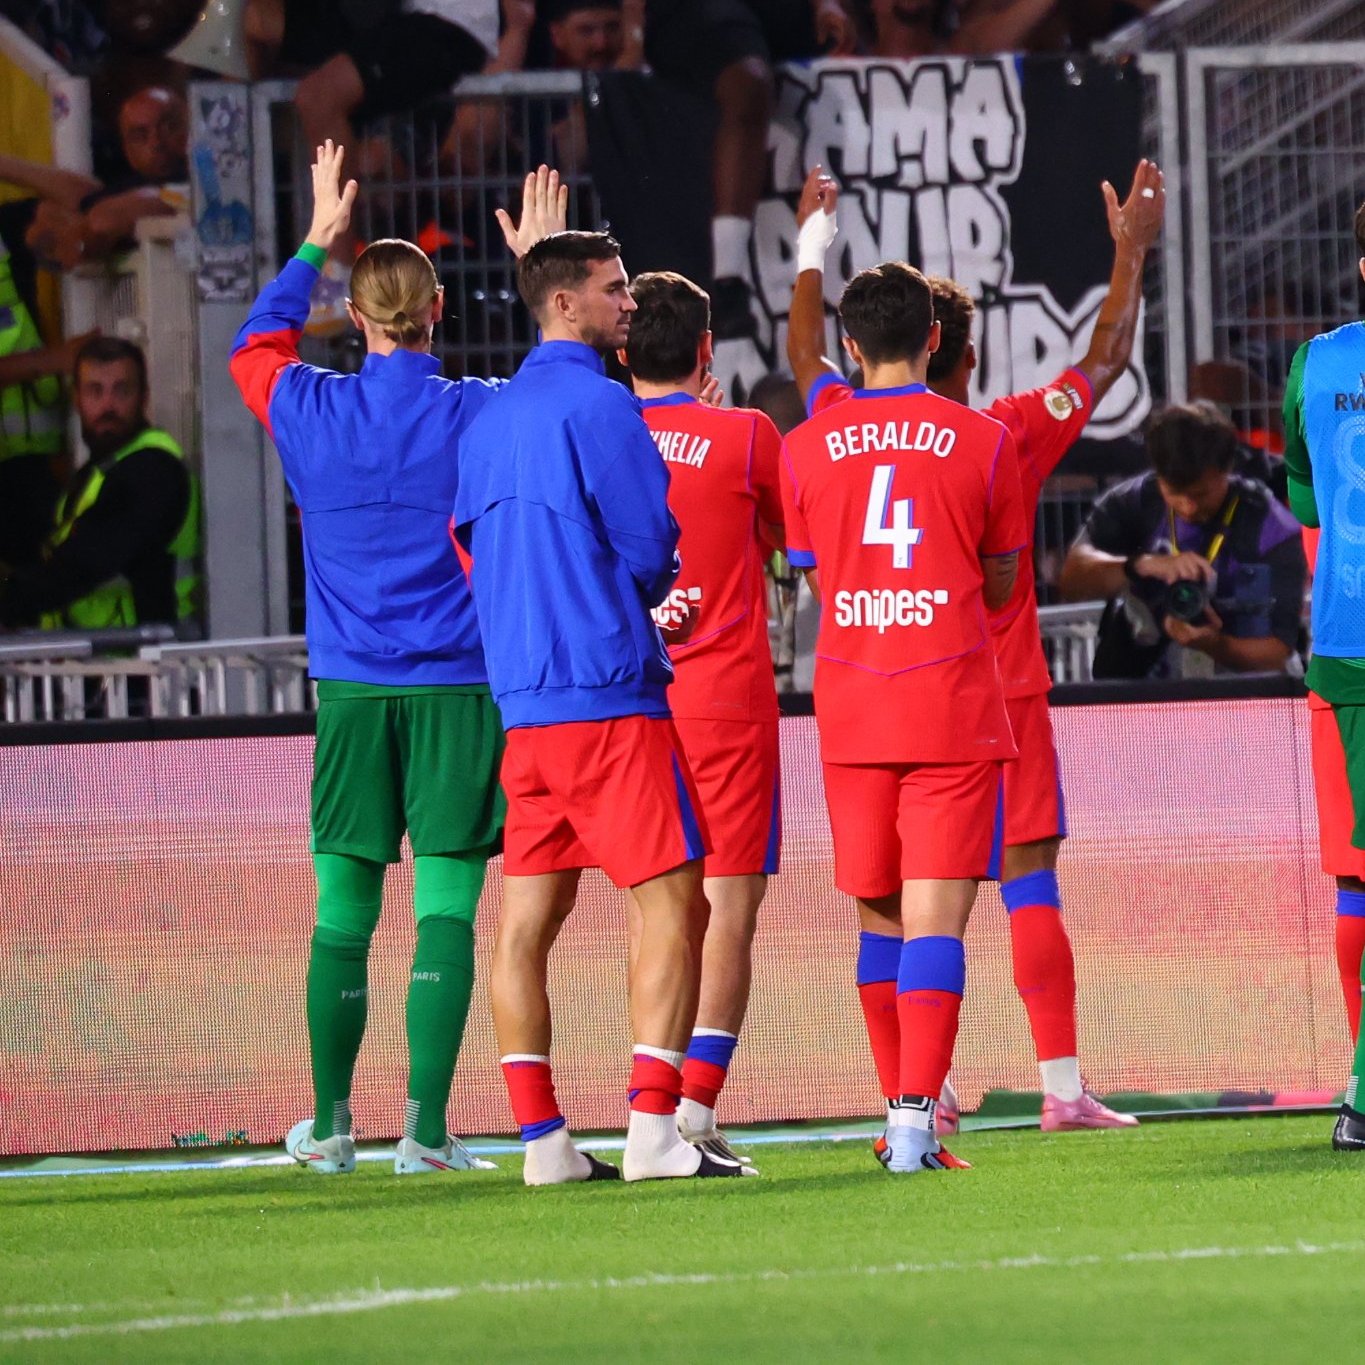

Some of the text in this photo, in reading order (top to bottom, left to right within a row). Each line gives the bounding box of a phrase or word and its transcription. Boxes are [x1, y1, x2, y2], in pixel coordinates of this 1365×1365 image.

[825, 420, 956, 463] BERALDO
[862, 464, 923, 569] 4
[835, 587, 934, 633] snipes
[412, 971, 440, 983] PARIS
